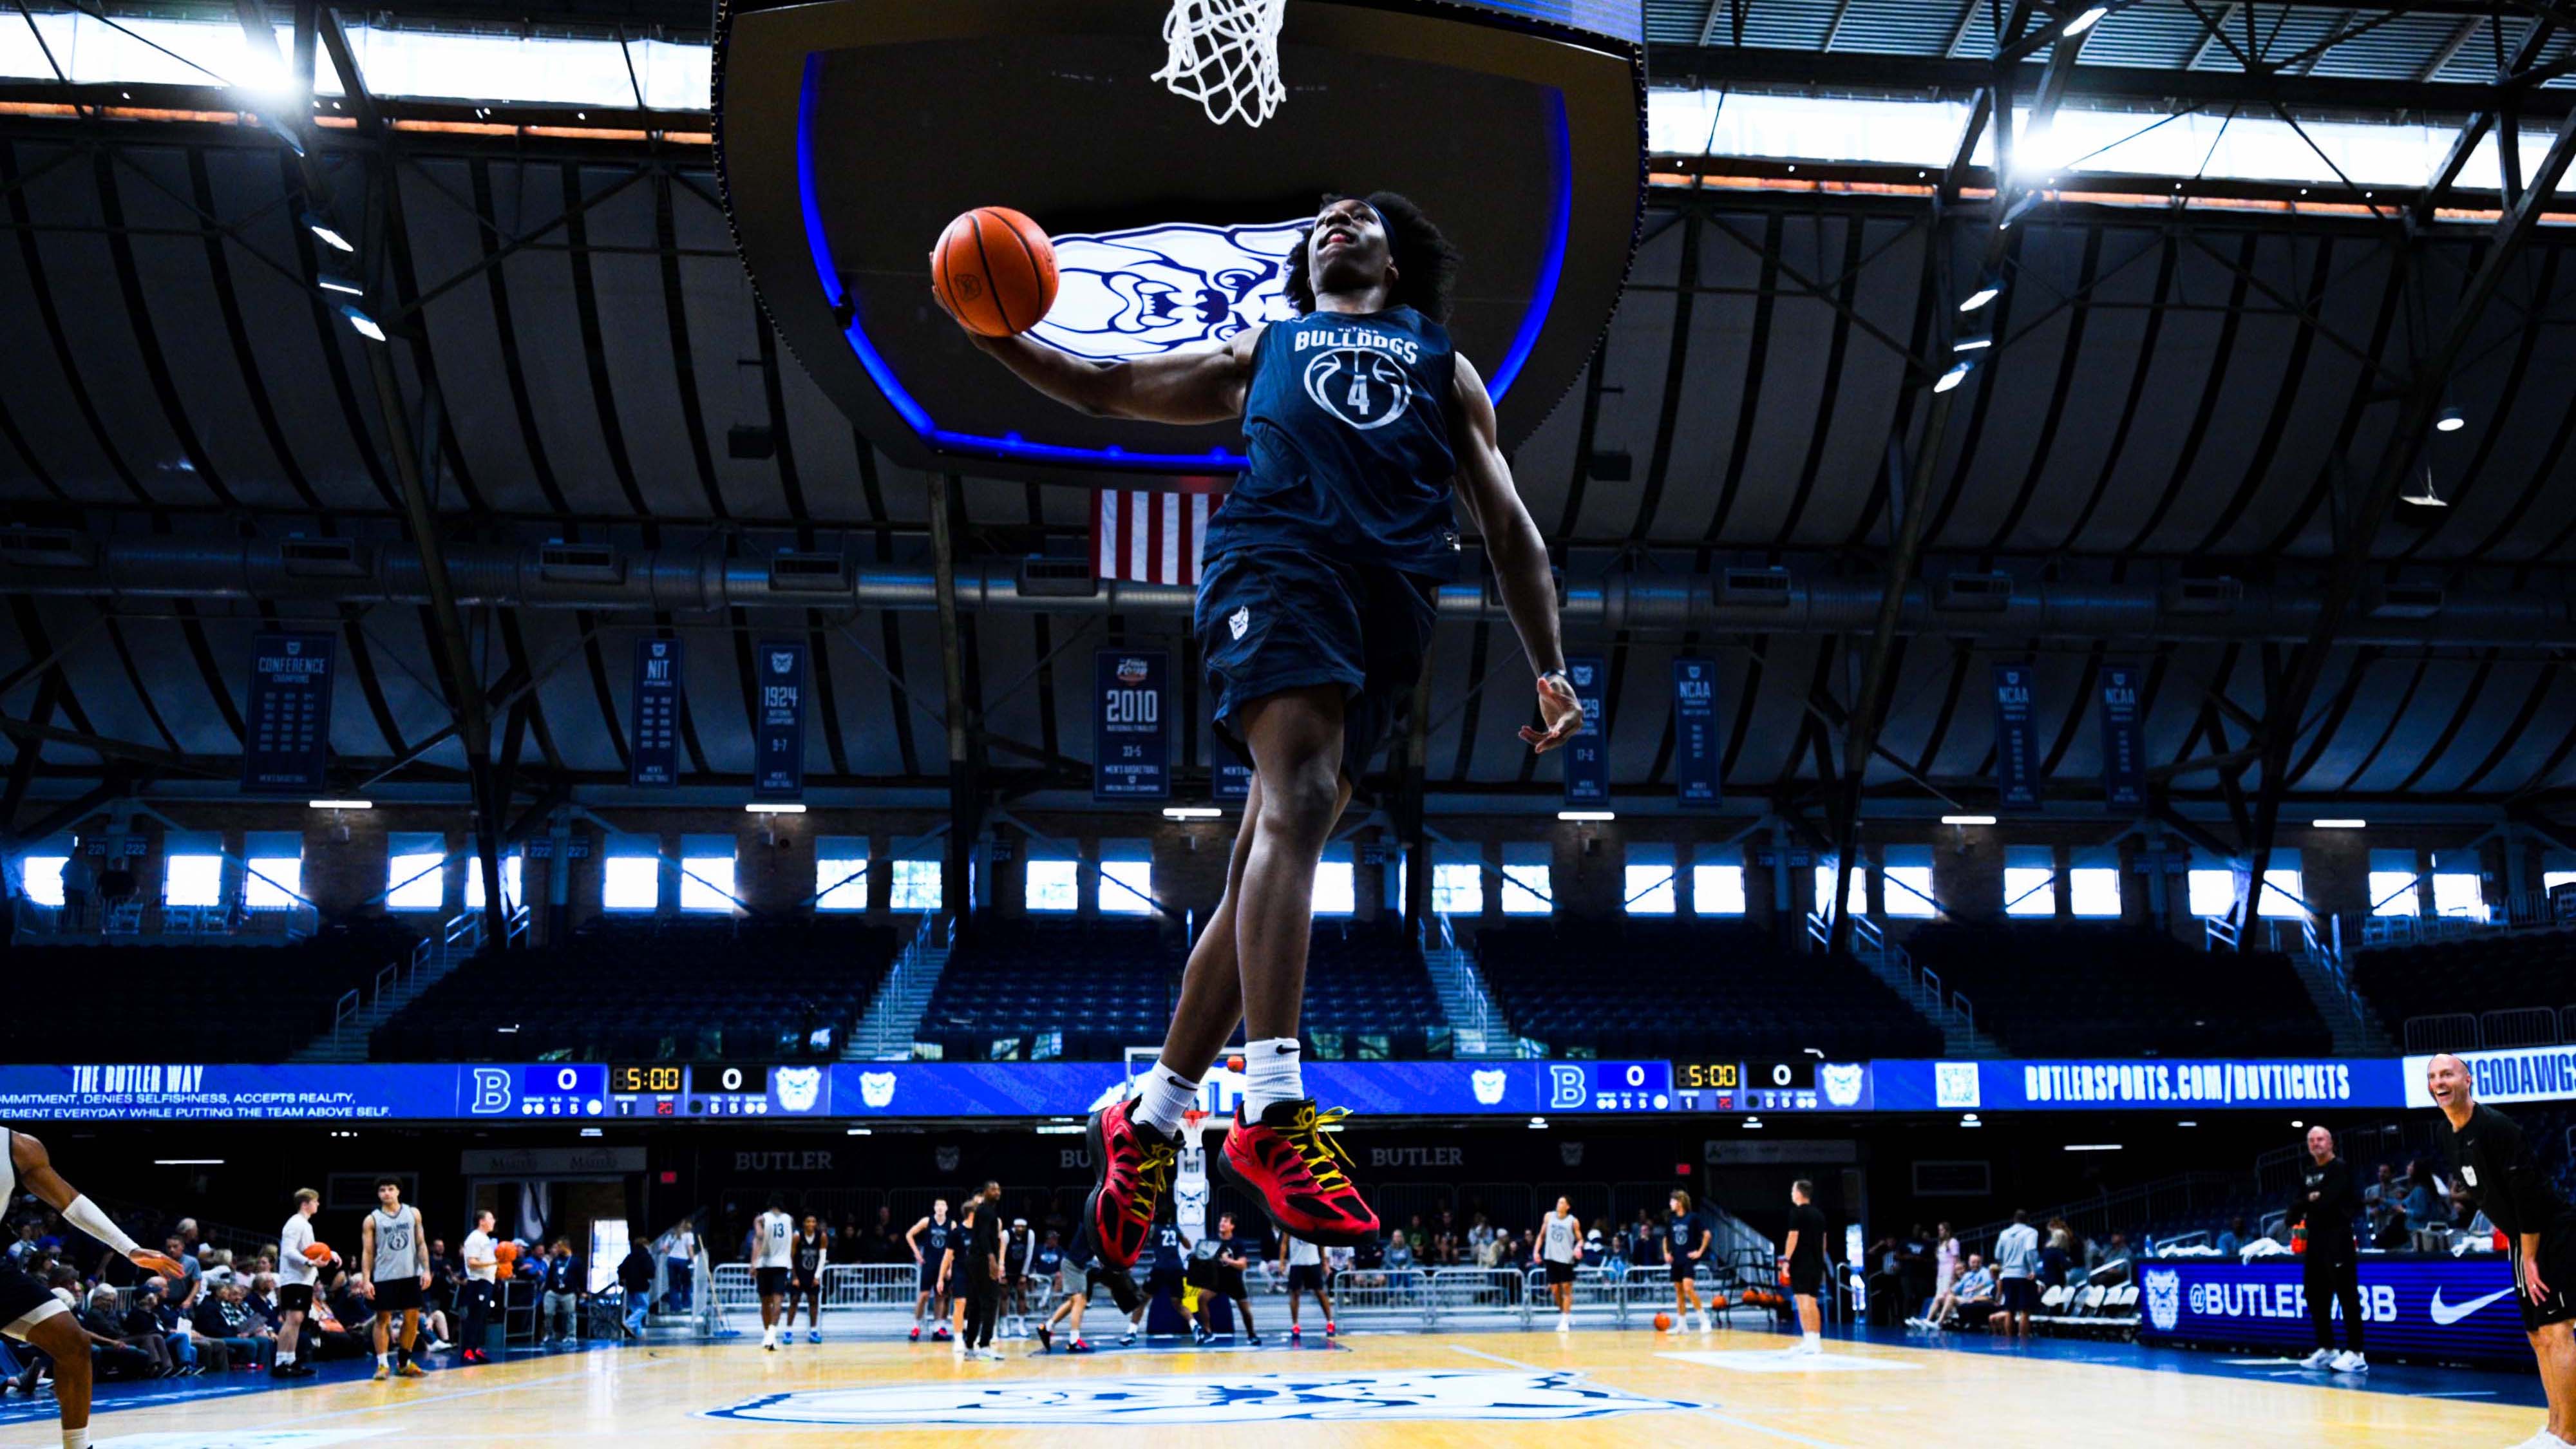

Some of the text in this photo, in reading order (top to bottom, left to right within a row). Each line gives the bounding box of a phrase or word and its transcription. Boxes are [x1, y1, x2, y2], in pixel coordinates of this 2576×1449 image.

[1294, 330, 1419, 365] BULLDOGS
[1347, 375, 1369, 415] 4
[259, 657, 325, 673] CONFERENCE
[647, 659, 670, 679] NIT
[765, 687, 798, 707] 1924
[1680, 681, 1710, 697] NCAA
[1999, 687, 2029, 703] NCAA
[2105, 688, 2136, 705] NCAA
[1106, 690, 1158, 722] 2010
[73, 1065, 204, 1093] THE BUTLER WAY
[557, 1068, 577, 1090] 0
[627, 1068, 679, 1090] 5:00
[722, 1068, 742, 1090] 0
[1626, 1065, 1645, 1086] 0
[1689, 1065, 1736, 1086] 5:00
[1772, 1065, 1792, 1086] 0
[2025, 1063, 2351, 1103] BUTLERSPORTS.COM/BUYTICKETS
[472, 1068, 511, 1113] B
[1550, 1065, 1587, 1108] B
[0, 1093, 356, 1105] MMITMENT, DENIES SELFISHNESS, ACCEPTS REALITY,
[621, 1102, 628, 1115] 1
[54, 1108, 126, 1118] EVERYDAY
[130, 1108, 172, 1118] WHILE
[176, 1108, 233, 1118] PUTTING
[237, 1108, 262, 1117] THE
[266, 1107, 303, 1117] TEAM
[307, 1106, 353, 1117] ABOVE
[356, 1106, 392, 1117] SELF.
[735, 1150, 834, 1170] BUTLER
[1372, 1148, 1463, 1167] BUTLER
[773, 1223, 784, 1238] 13
[1160, 1229, 1177, 1247] 23
